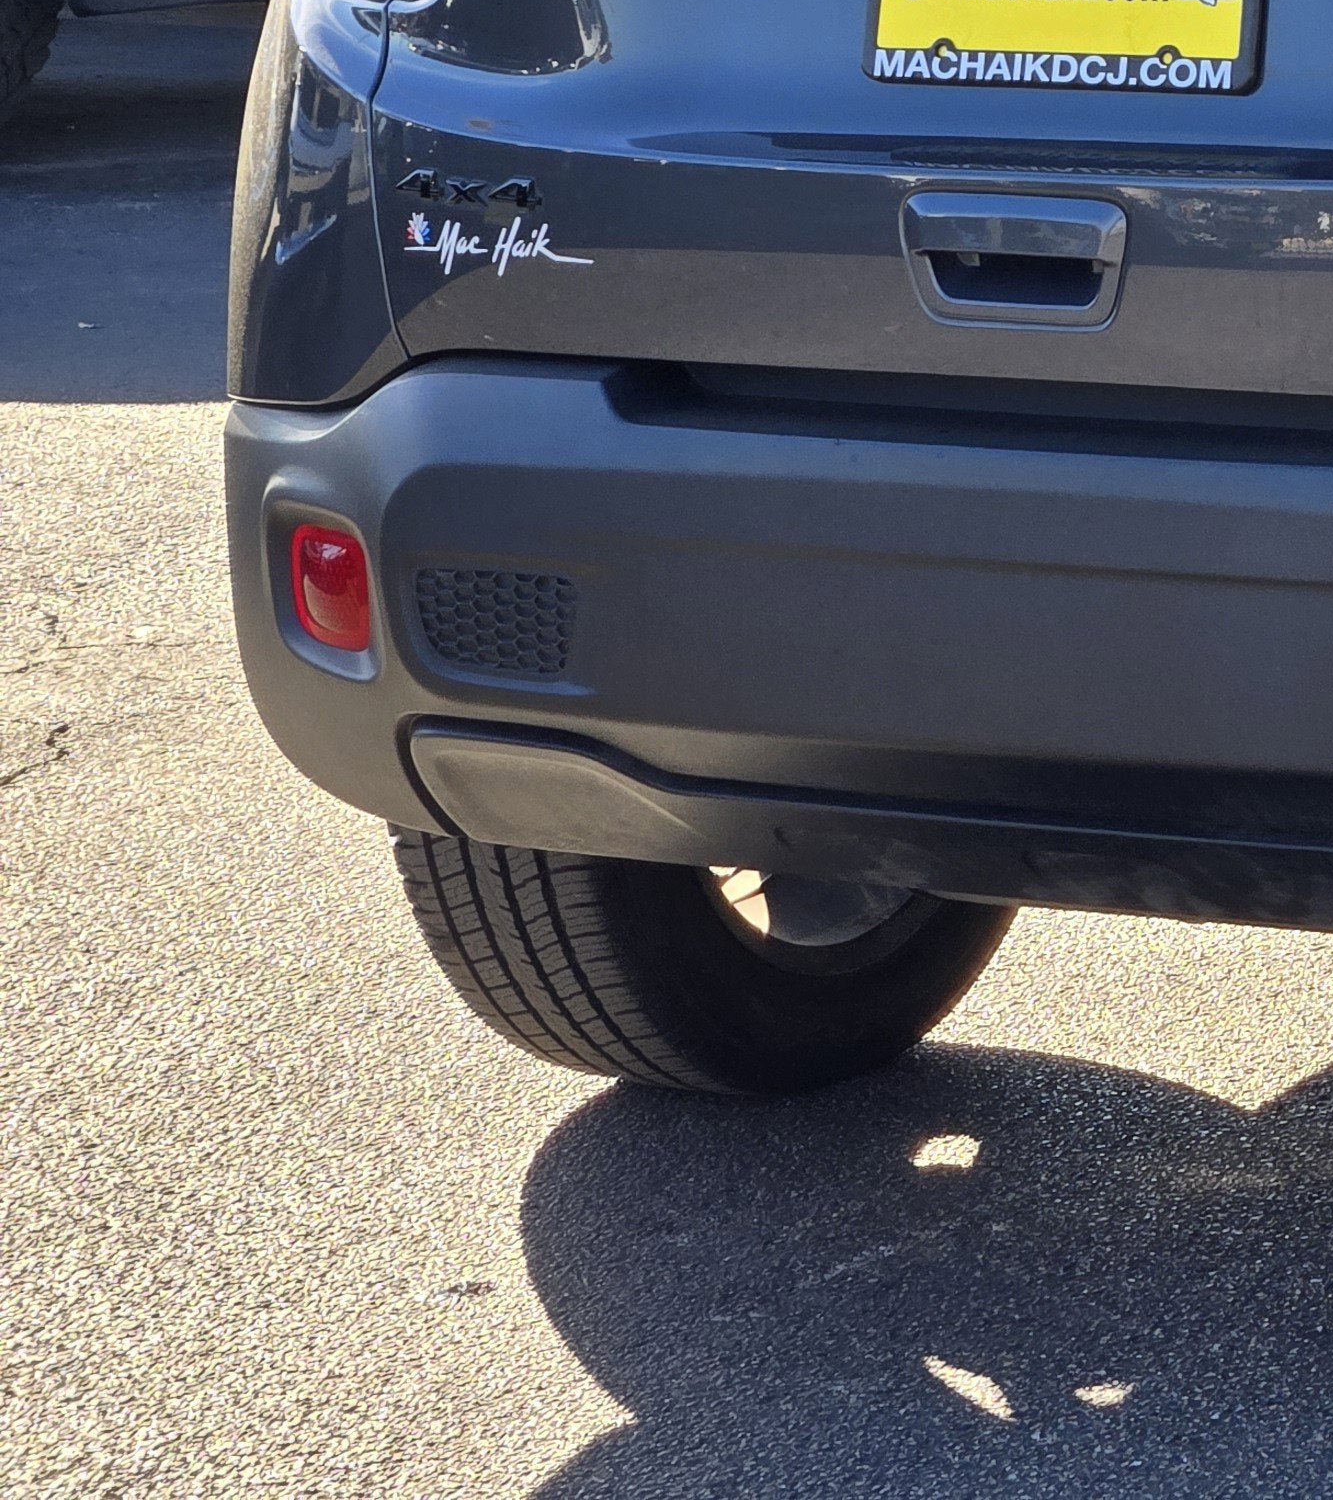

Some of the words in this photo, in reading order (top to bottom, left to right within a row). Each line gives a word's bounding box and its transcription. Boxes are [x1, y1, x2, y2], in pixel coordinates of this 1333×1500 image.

[873, 49, 1233, 90] MACHAIKDCJ.COM
[404, 219, 489, 275] Mac
[491, 216, 595, 277] Haik
